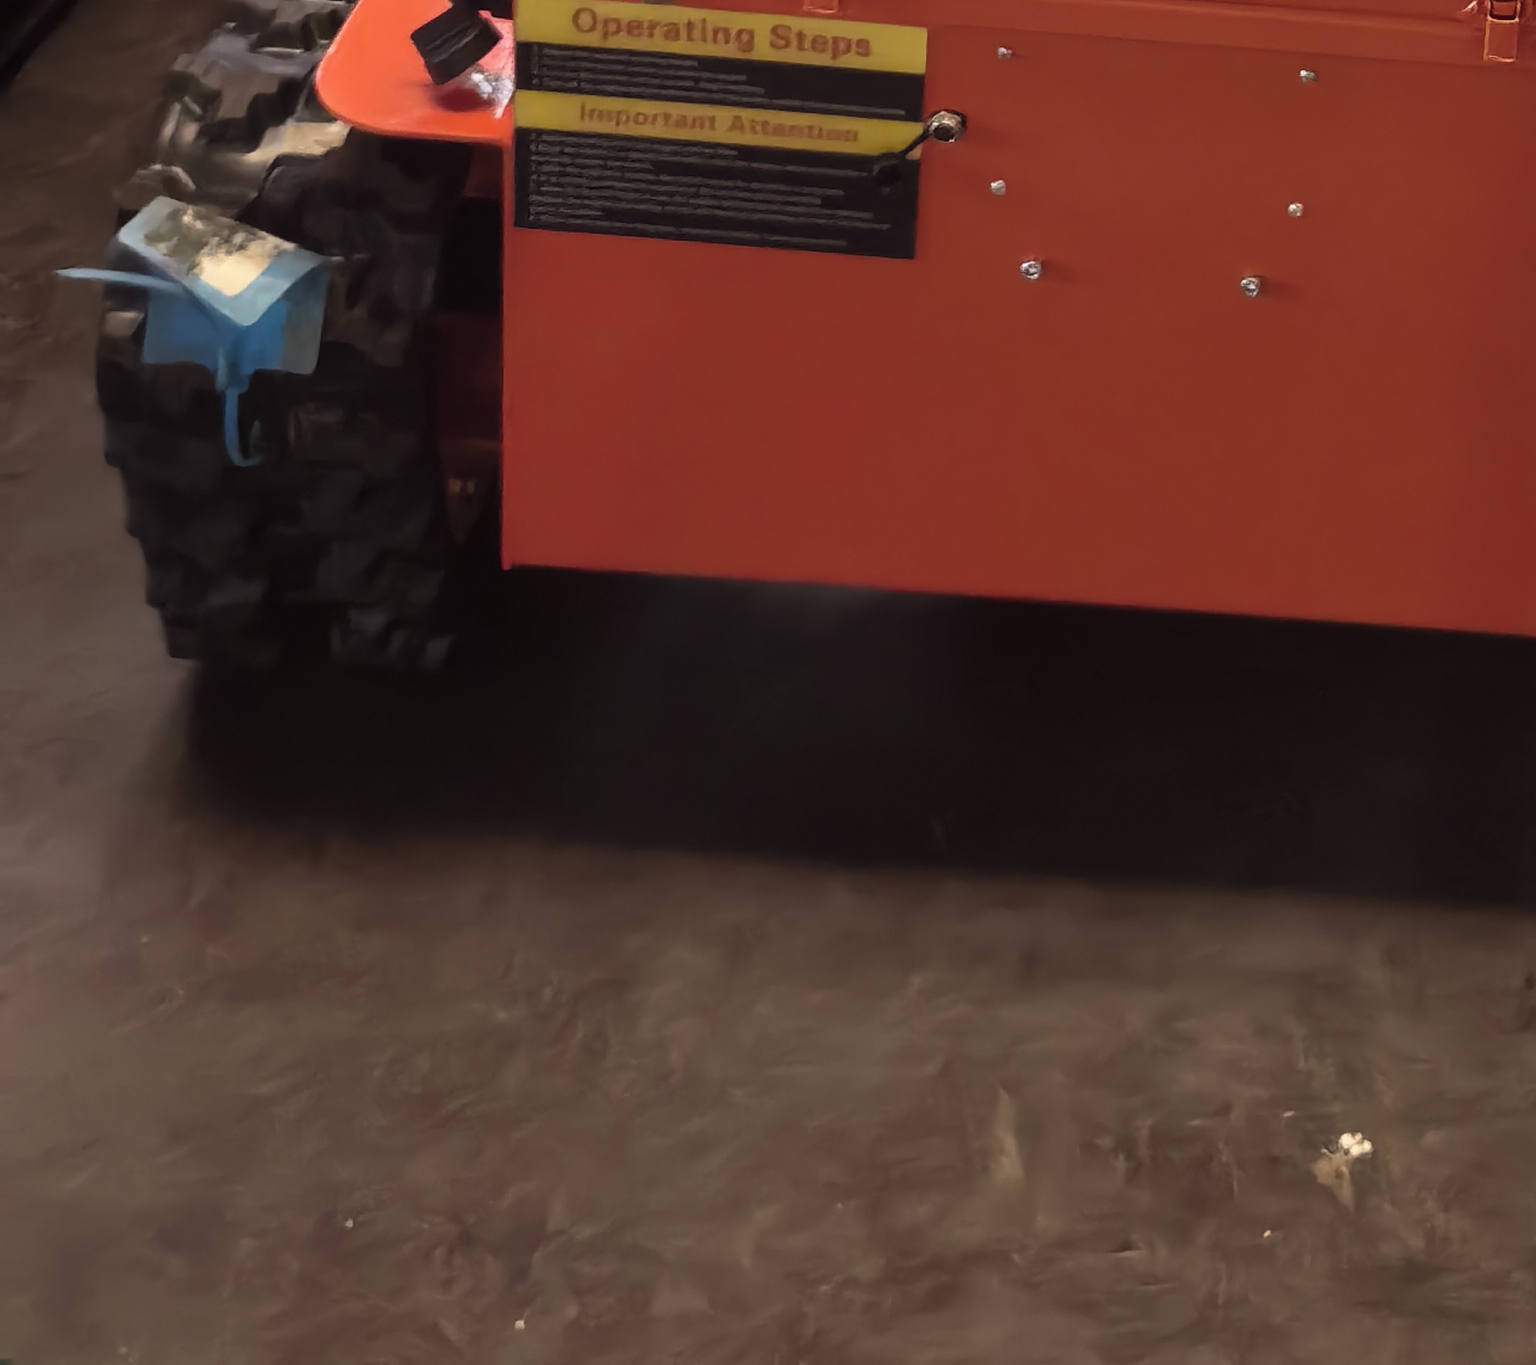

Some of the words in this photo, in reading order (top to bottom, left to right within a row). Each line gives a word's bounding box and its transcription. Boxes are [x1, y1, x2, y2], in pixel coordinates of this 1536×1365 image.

[571, 7, 756, 53] Operating
[769, 24, 872, 60] Steps
[580, 101, 718, 131] Important
[727, 114, 859, 144] Attention
